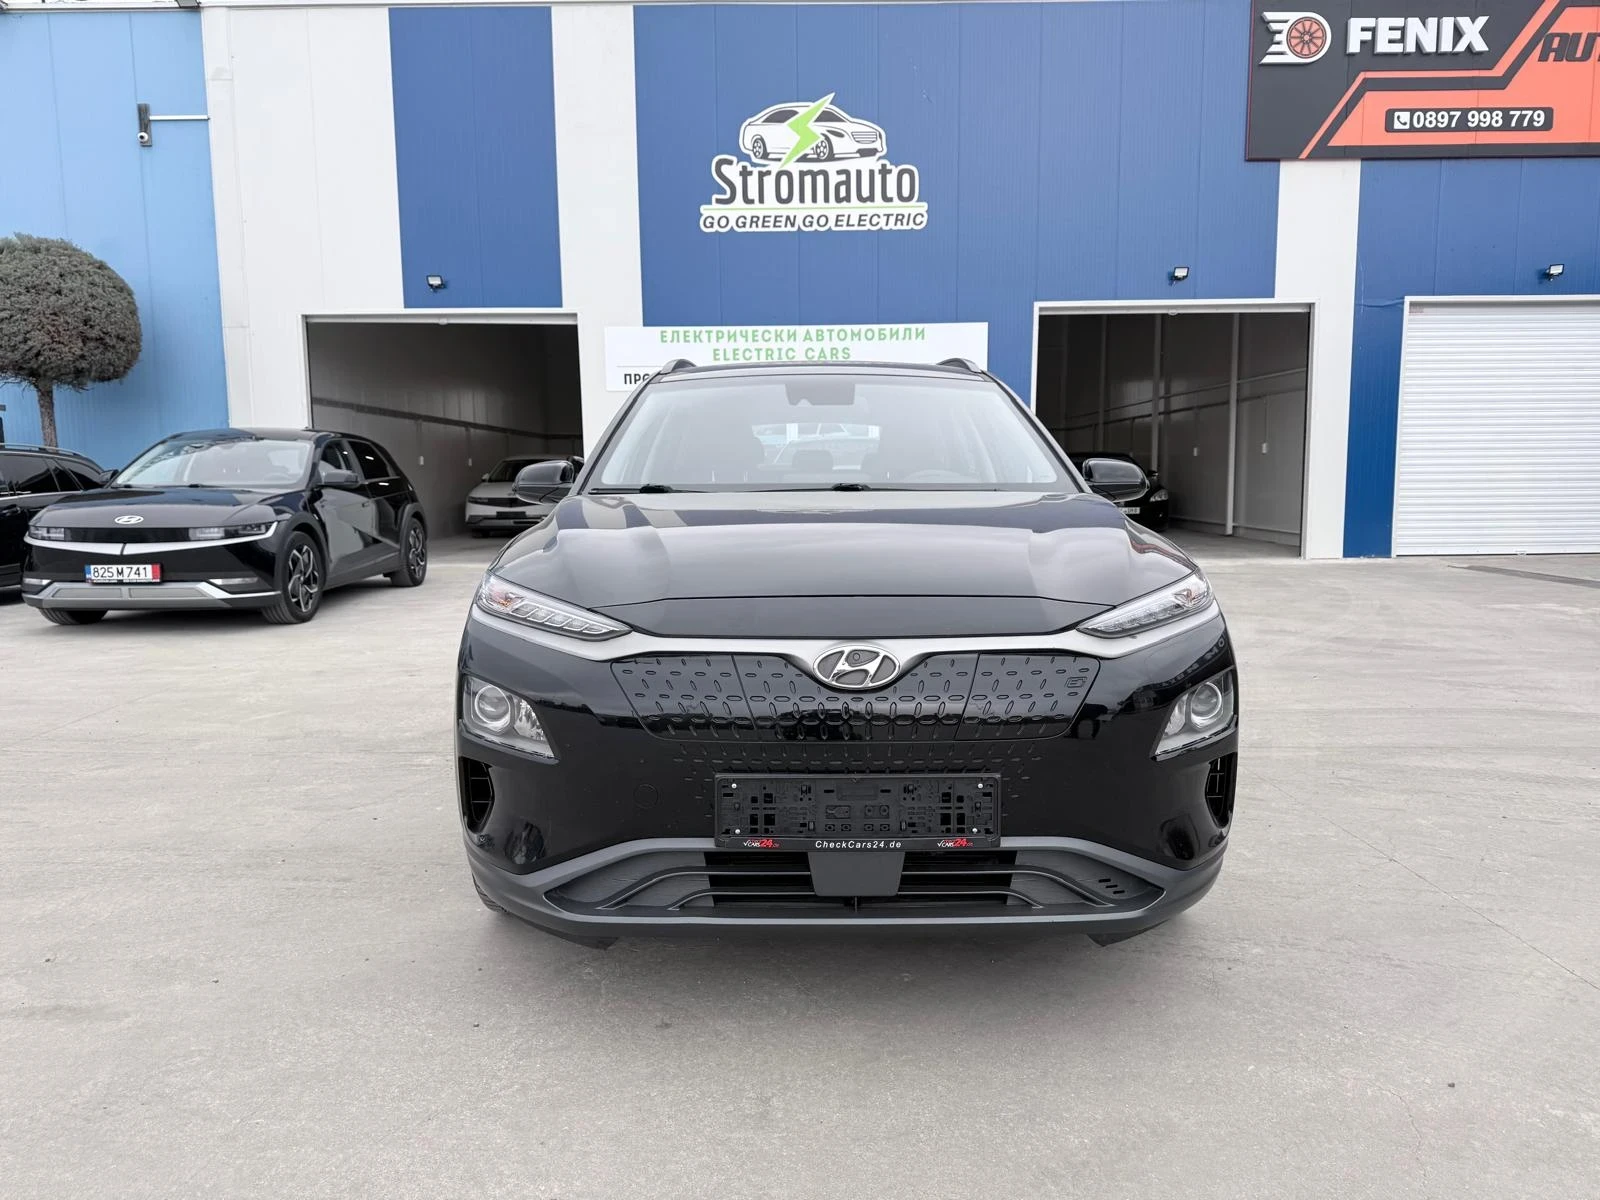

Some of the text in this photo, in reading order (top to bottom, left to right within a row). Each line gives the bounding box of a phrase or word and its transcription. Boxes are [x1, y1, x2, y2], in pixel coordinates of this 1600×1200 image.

[1346, 16, 1490, 54] FENIX
[1537, 32, 1600, 62] AU
[1412, 110, 1545, 128] 0897 998 779
[713, 158, 917, 205] Stromauto
[702, 213, 925, 229] GO GREEN GO ELECTRIC
[660, 327, 926, 343] ЕЛЕКТРИЧЕСКИ АВТОМОБИЛИ
[712, 347, 851, 361] ELECTRIC CARS
[815, 840, 902, 849] CheckCars24.de
